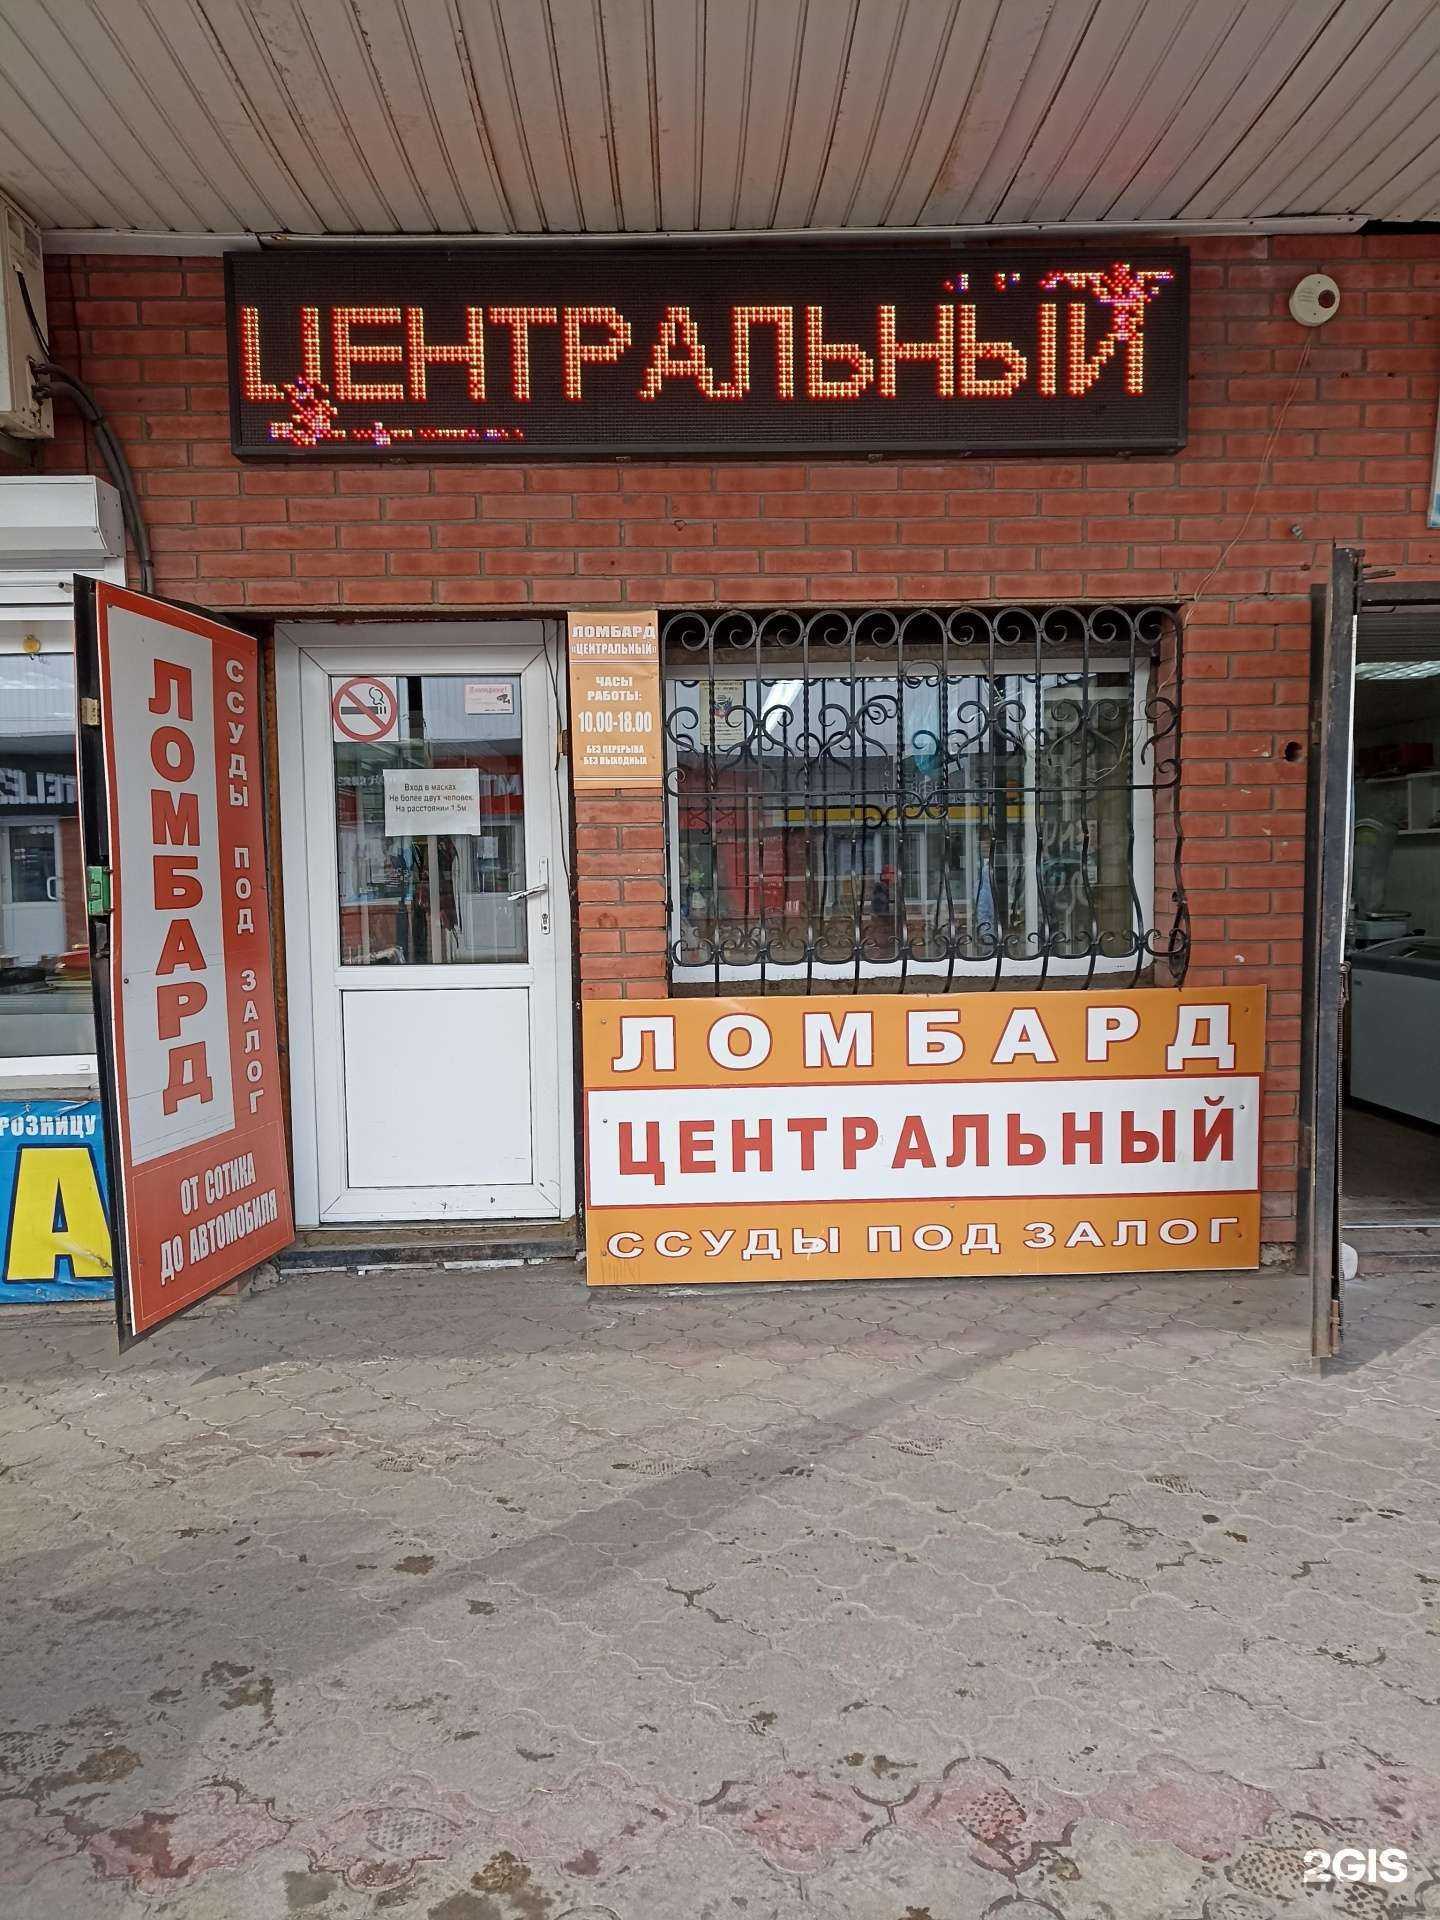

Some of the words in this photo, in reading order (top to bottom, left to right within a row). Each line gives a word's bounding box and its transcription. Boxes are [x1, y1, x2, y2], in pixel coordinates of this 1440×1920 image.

[572, 625, 656, 639] ЛОМБАРД
[595, 676, 632, 687] ЧАСЫ
[225, 658, 250, 808] ССУДЫ
[578, 710, 652, 733] 10.00-18.00
[401, 794, 422, 802] более
[424, 795, 441, 803] двух
[405, 783, 423, 792] Вход
[148, 658, 214, 1116] ЛОМБАРД
[234, 846, 254, 935] ПОД
[241, 968, 264, 1114] ЗАЛОГ
[612, 1003, 1236, 1073] ЛОМБАРД
[0, 1114, 96, 1138] РОЗНИЦУ
[618, 1096, 1235, 1186] ЦЕНТРАЛЬНЫЙ
[180, 1175, 199, 1216] ОТ
[204, 1152, 257, 1205] СОТИКА
[160, 1235, 184, 1286] ДО
[189, 1188, 278, 1265] АВТОМОБИЛЯ
[606, 1225, 841, 1262] ССУДЫ
[867, 1221, 1001, 1256] ПОД
[1023, 1216, 1241, 1249] ЗАЛОГ
